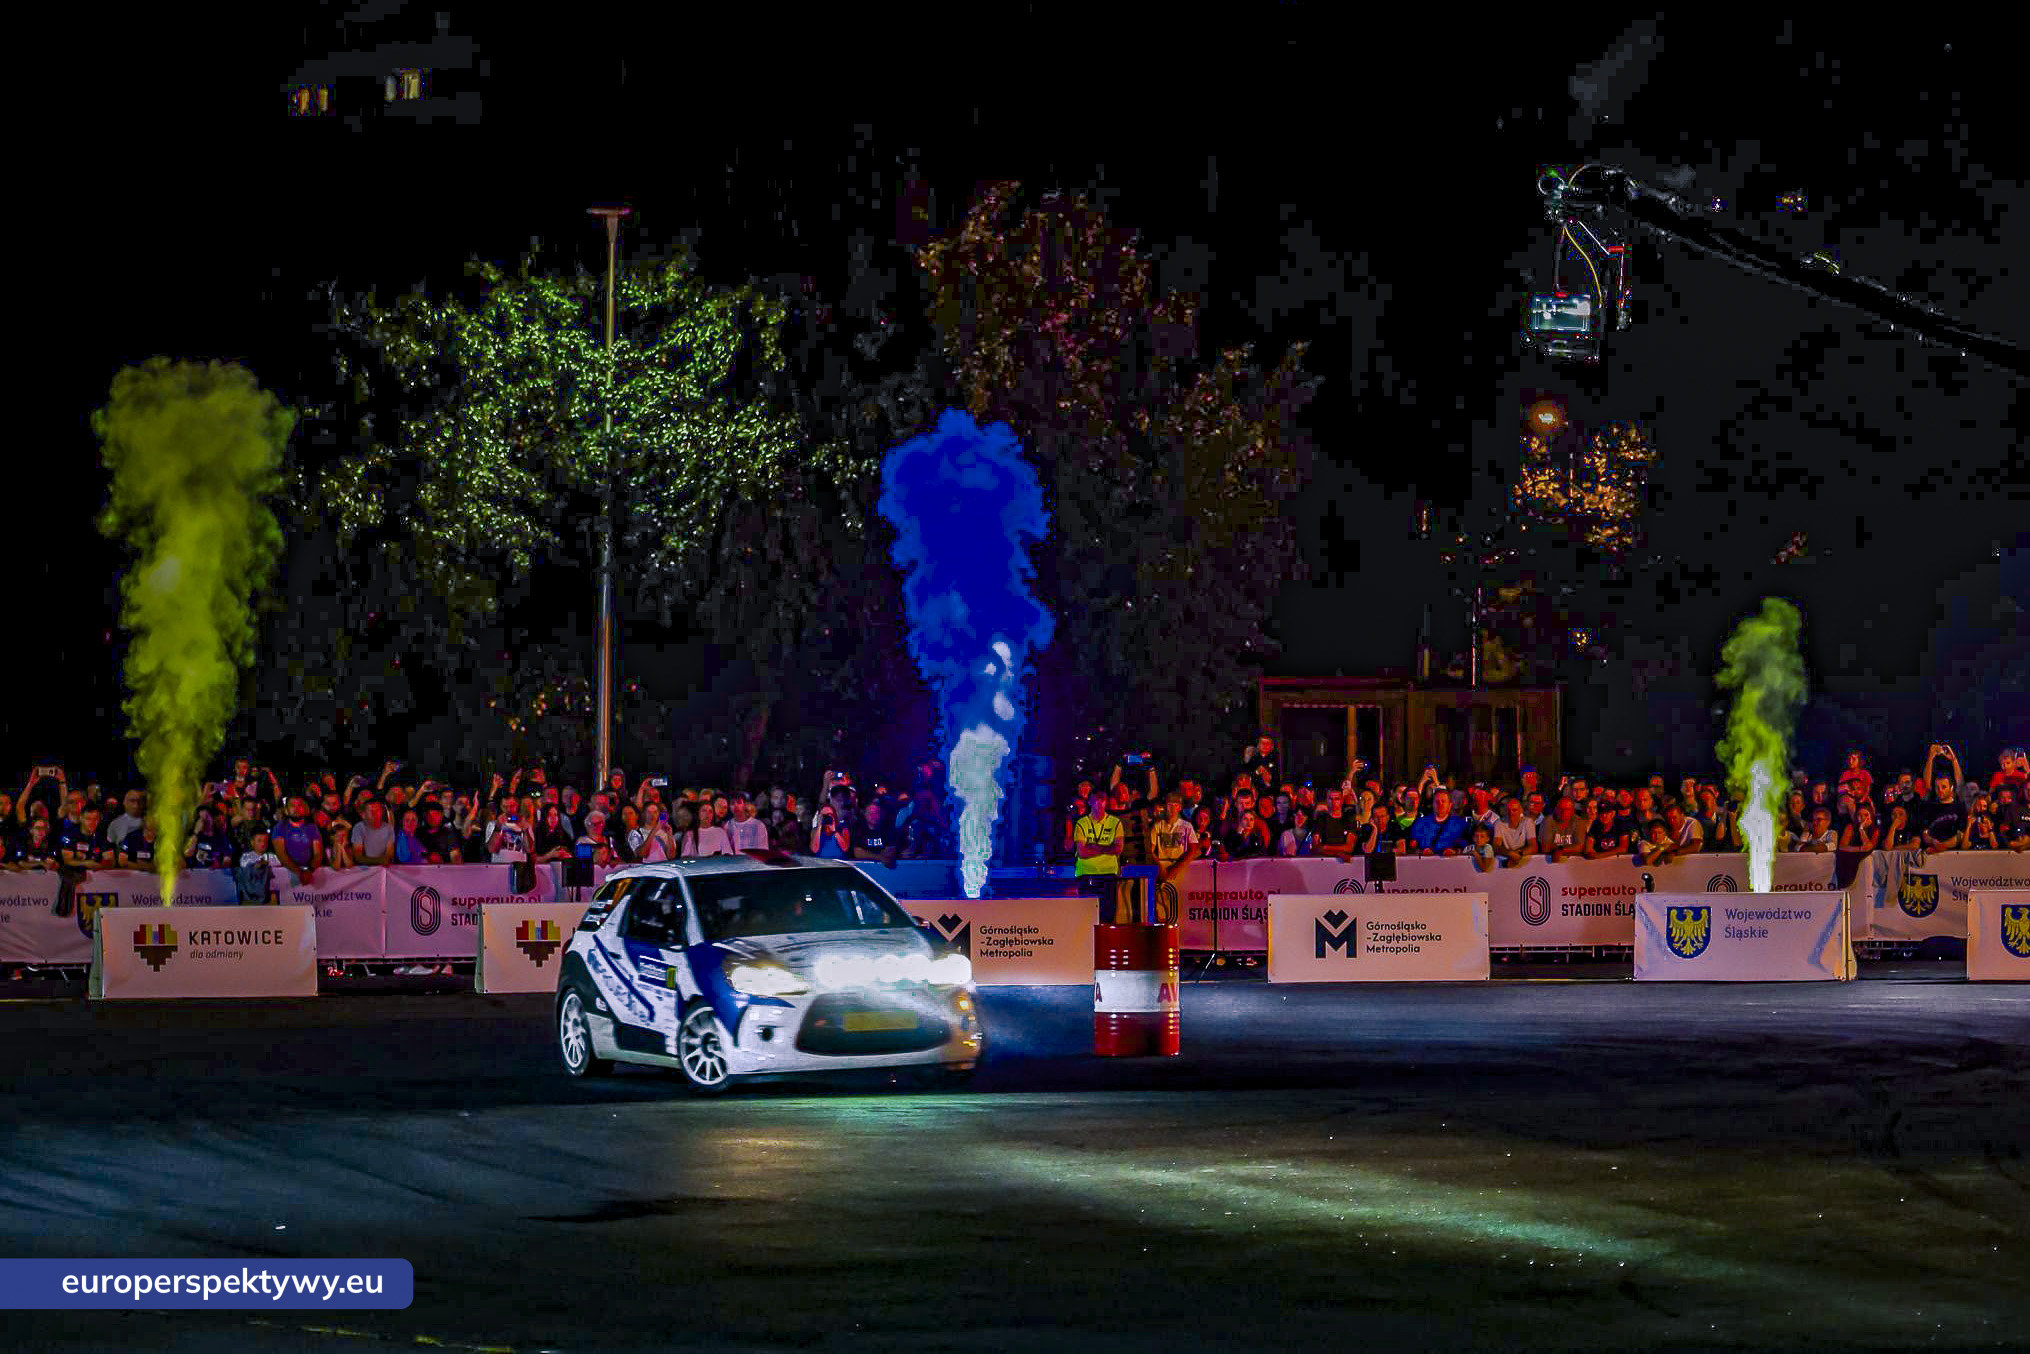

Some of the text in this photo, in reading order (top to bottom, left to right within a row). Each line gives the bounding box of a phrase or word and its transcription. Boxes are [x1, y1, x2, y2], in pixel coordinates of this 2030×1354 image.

[1189, 907, 1238, 920] STADION
[1561, 904, 1611, 916] STADION
[1725, 908, 1811, 921] Województwo
[979, 924, 1040, 936] Górnośląsko
[1366, 920, 1427, 933] Górnośląsko
[1725, 926, 1769, 939] Śląskie
[188, 930, 283, 945] KATOWICE
[190, 949, 244, 960] dla odmiany
[979, 947, 1033, 959] Metropolia
[1366, 944, 1421, 955] Metropolia
